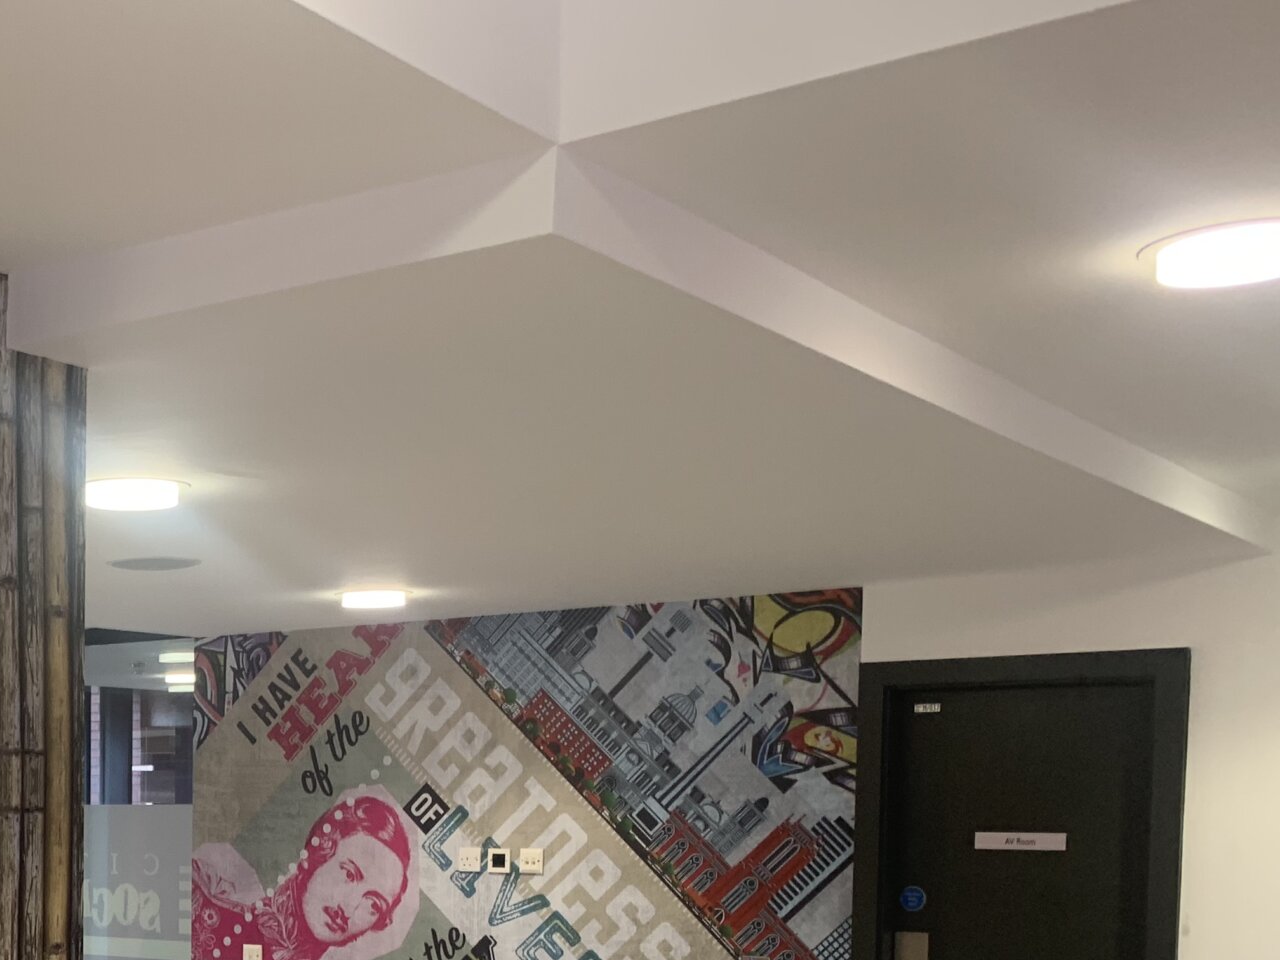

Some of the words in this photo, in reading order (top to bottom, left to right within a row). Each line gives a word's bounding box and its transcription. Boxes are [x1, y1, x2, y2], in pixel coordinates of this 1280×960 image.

[236, 720, 257, 746] I
[251, 648, 317, 727] HAVE
[301, 745, 333, 797] of
[325, 711, 370, 762] the
[409, 792, 445, 827] OF
[1004, 837, 1015, 846] AV
[1016, 838, 1036, 847] Room
